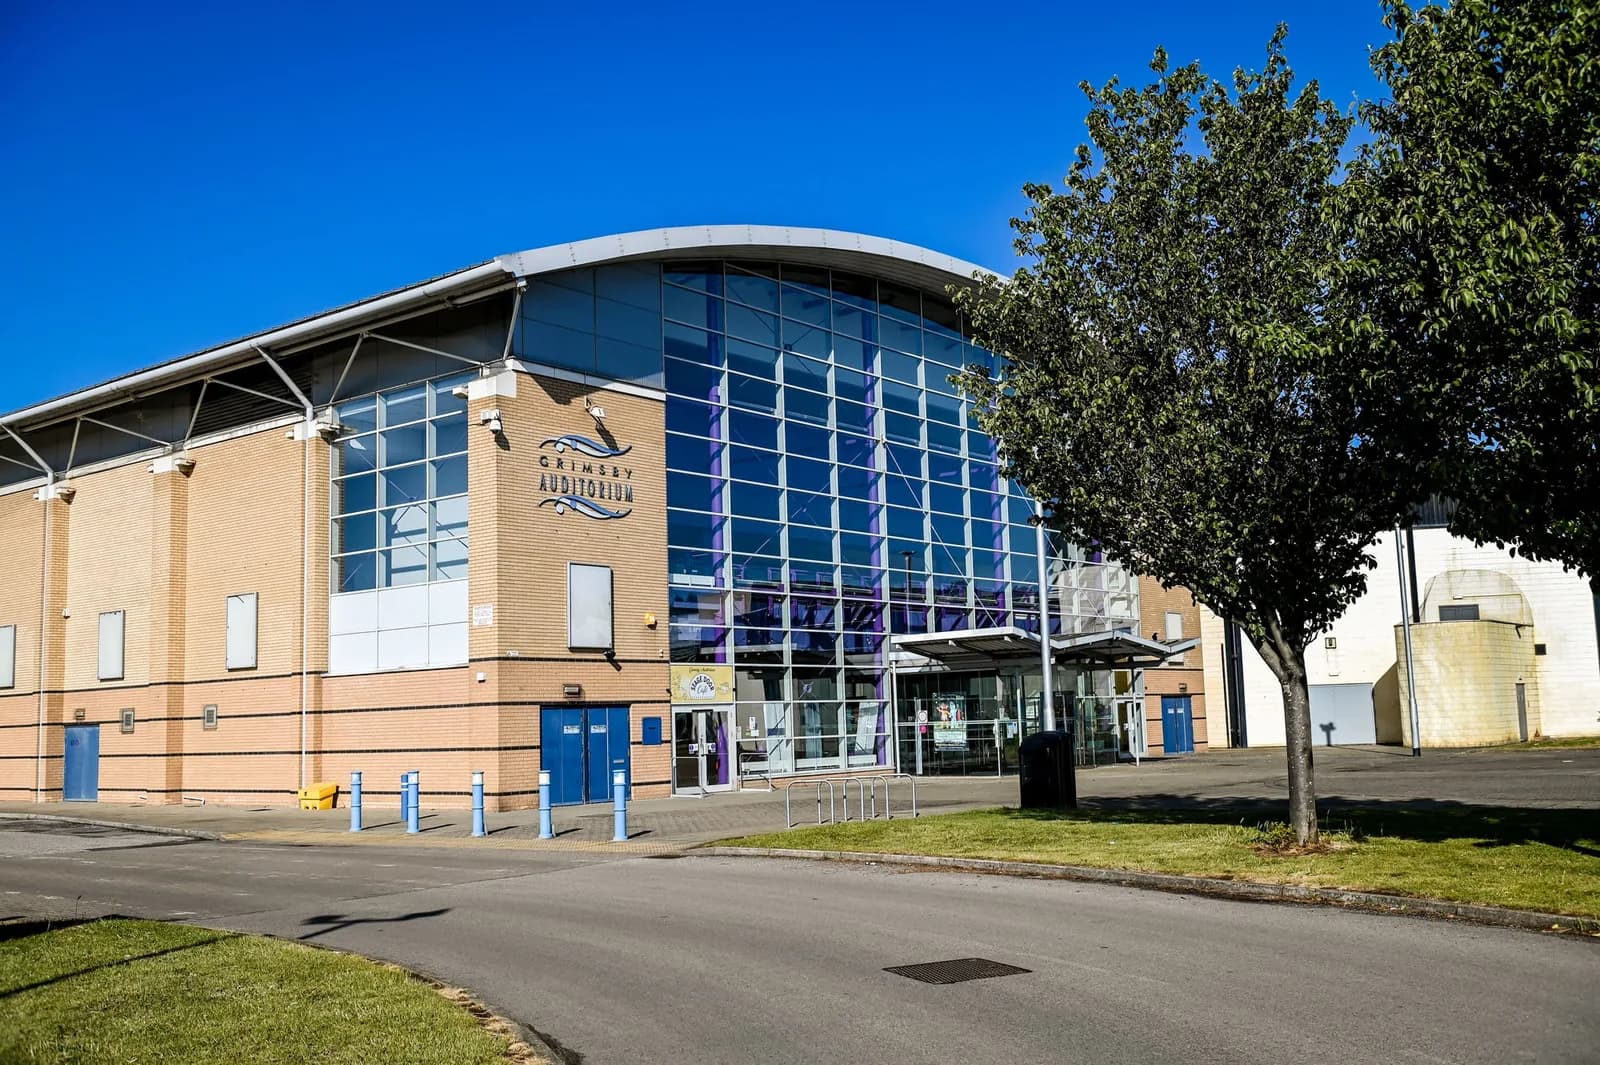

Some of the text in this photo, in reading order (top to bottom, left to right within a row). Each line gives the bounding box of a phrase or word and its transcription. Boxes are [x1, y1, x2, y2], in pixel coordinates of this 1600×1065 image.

[539, 455, 633, 479] GRIMSBY
[539, 472, 634, 503] AUDITORIUM
[690, 675, 715, 691] STAGE DOOR
